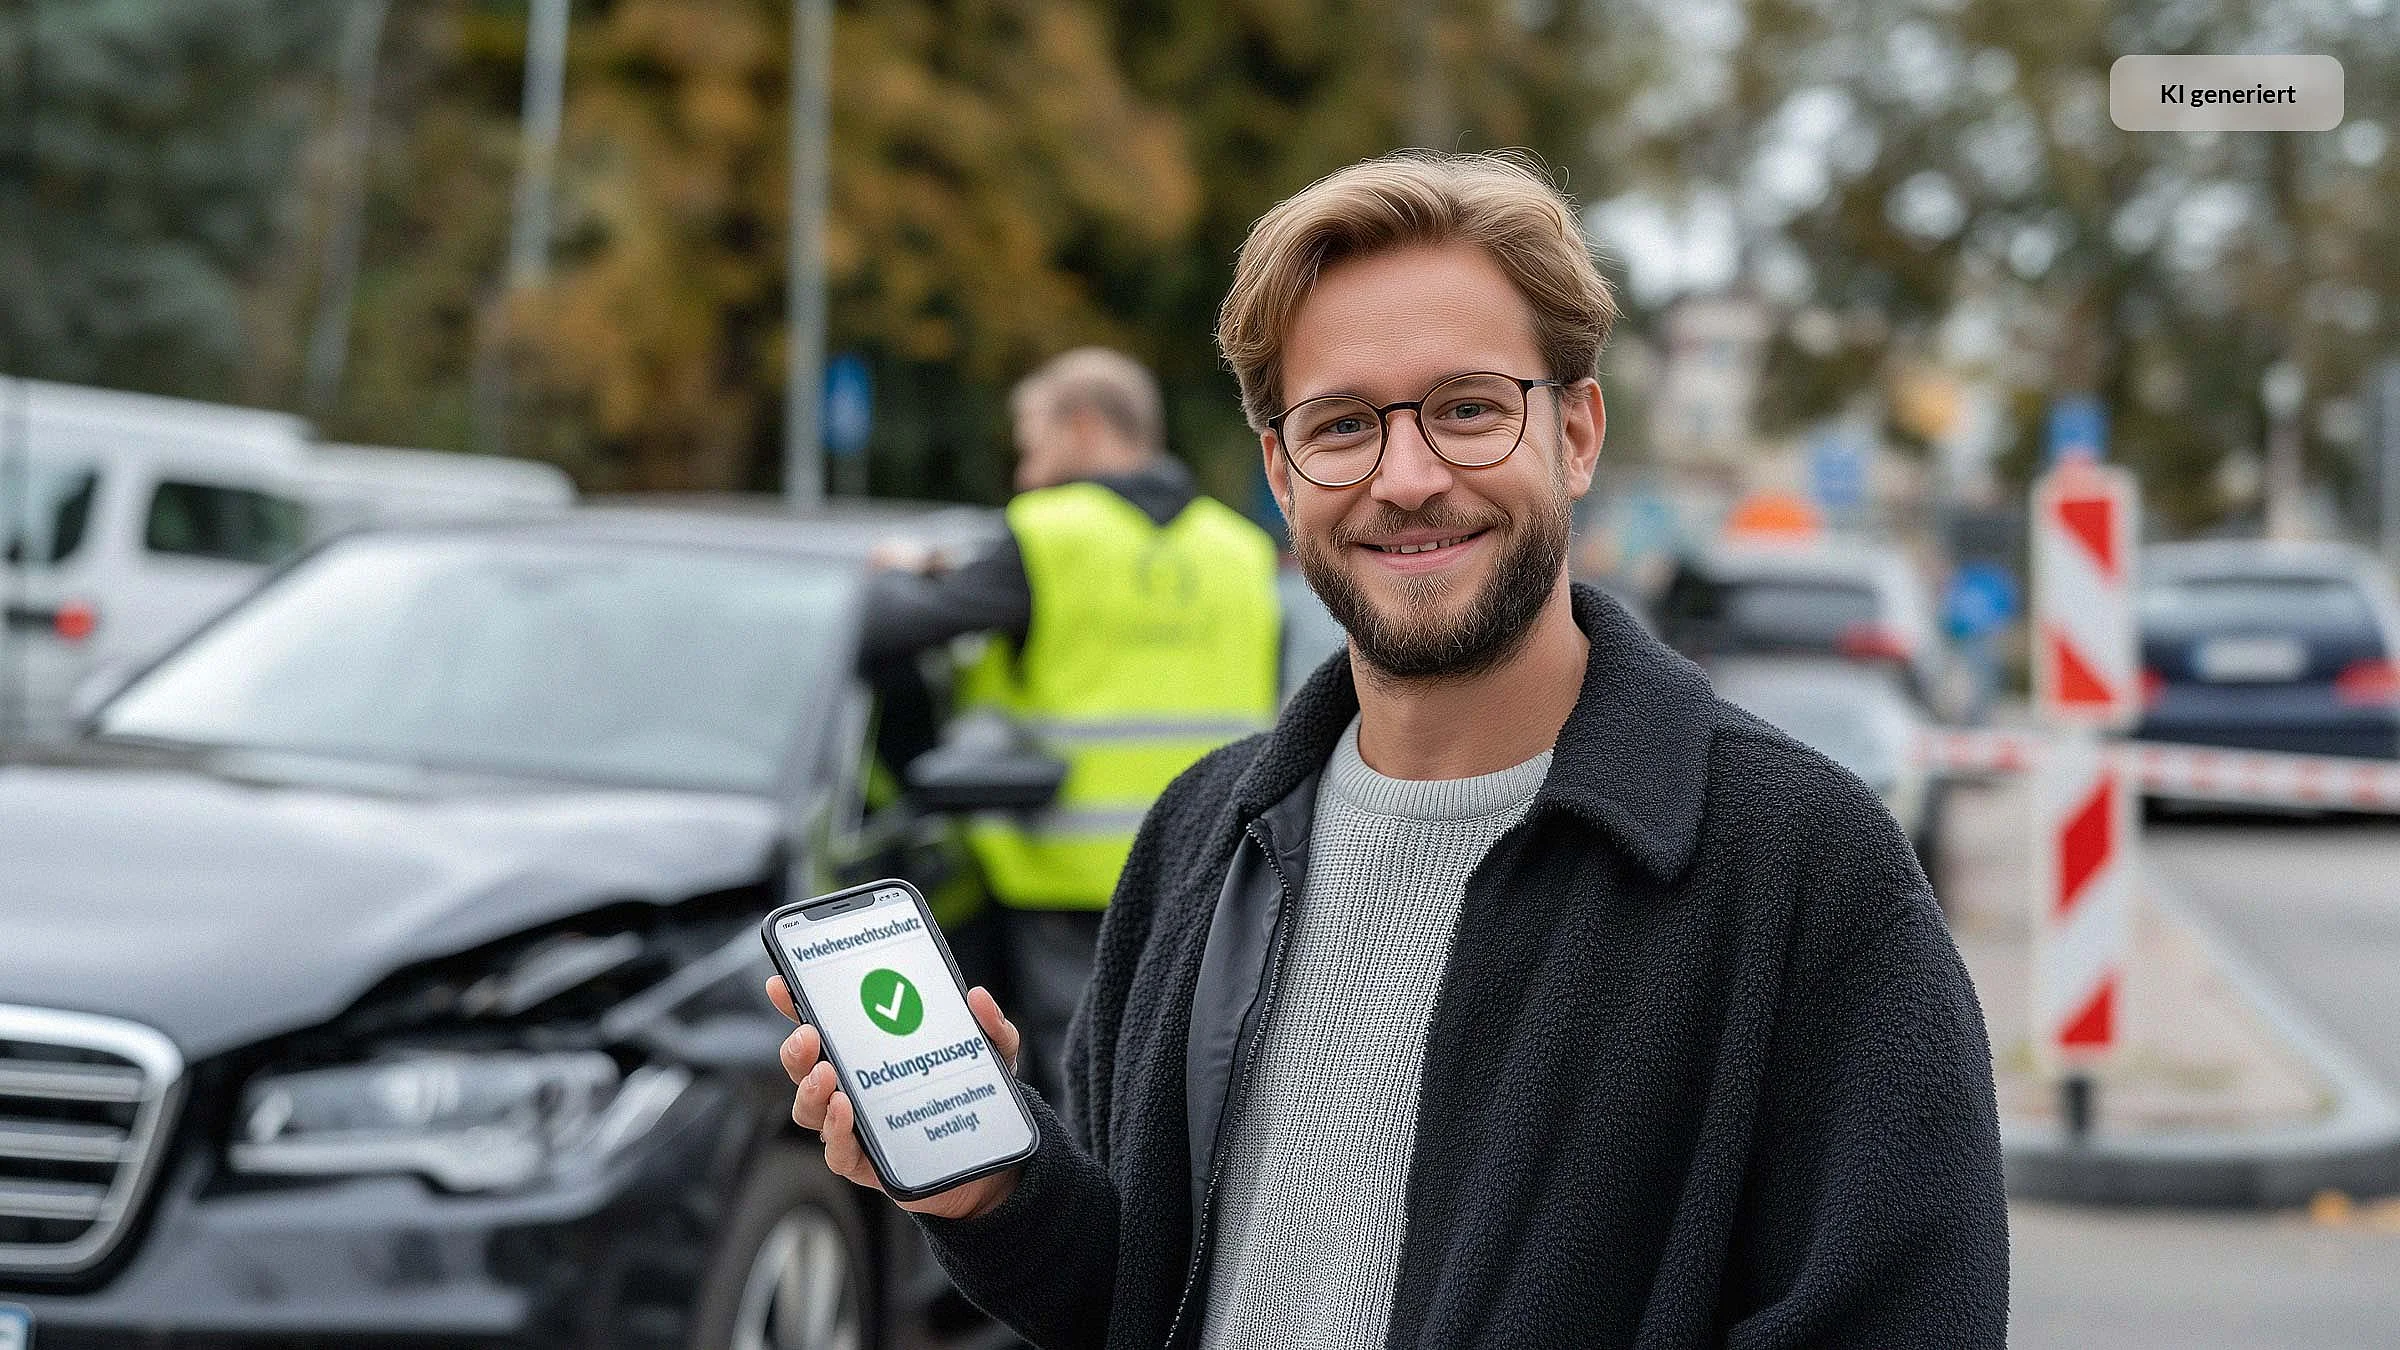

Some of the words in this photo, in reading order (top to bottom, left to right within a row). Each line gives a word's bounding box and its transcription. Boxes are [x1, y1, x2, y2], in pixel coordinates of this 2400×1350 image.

[792, 917, 922, 962] Verkehesrechtsschutz
[856, 1036, 985, 1090] Deckungszusage
[885, 1083, 996, 1131] Kostenübernahme
